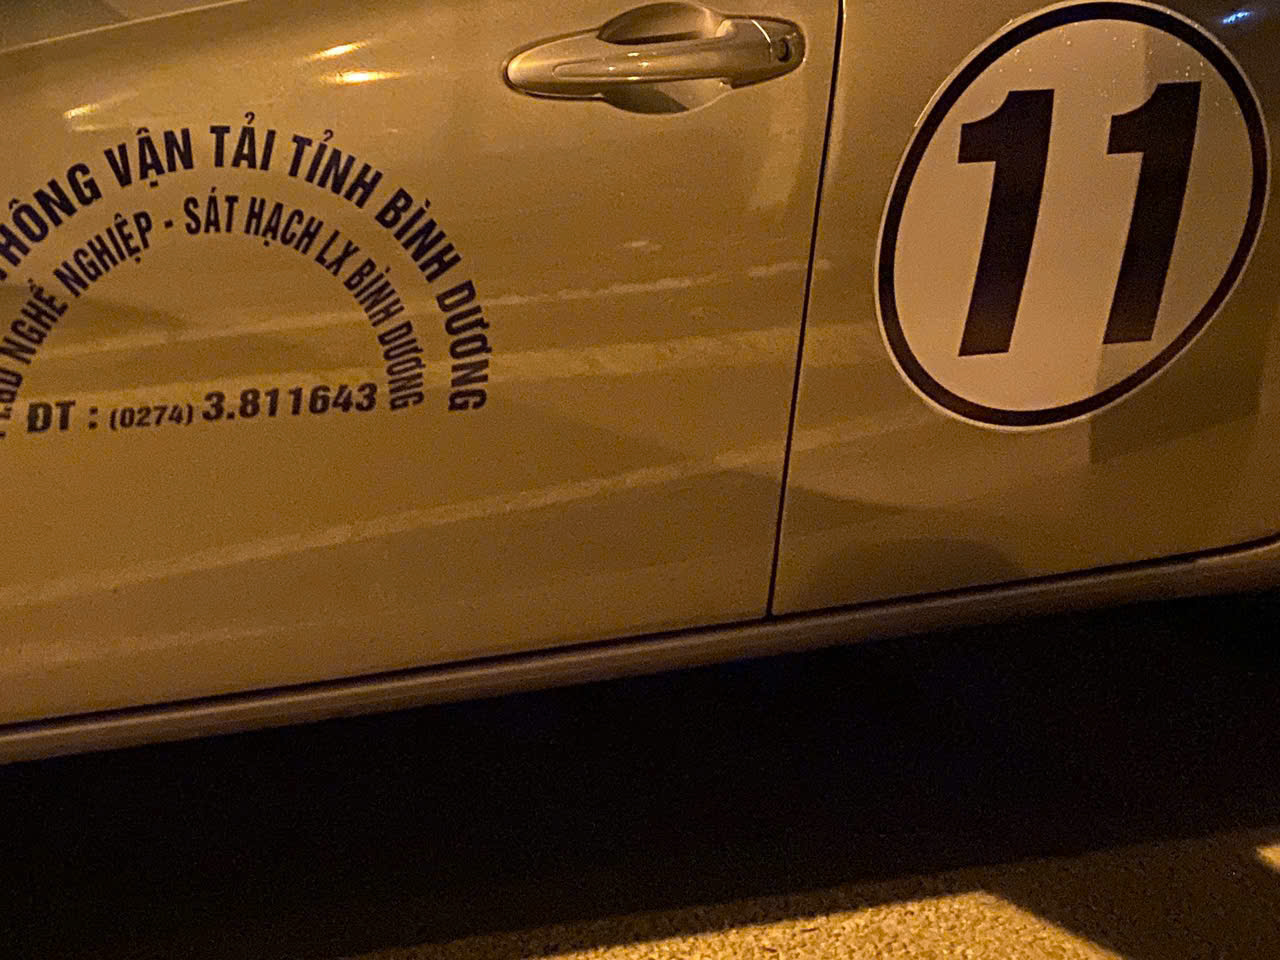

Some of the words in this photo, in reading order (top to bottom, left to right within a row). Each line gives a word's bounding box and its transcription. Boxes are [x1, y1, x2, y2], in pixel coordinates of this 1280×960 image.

[52, 212, 153, 298] NGHIỆP
[164, 219, 174, 229] -
[183, 186, 239, 235] SÁT
[244, 196, 324, 255] HẠCH
[314, 229, 360, 277] LX
[343, 256, 405, 328] BÌNH
[377, 320, 426, 411] DƯƠNG
[104, 127, 194, 188] VẬN
[209, 111, 277, 171] TẢI
[288, 129, 384, 209] TỈNH
[375, 187, 462, 283] BÌNH
[436, 279, 492, 412] DƯƠNG
[957, 80, 1202, 358] 11
[109, 403, 193, 431] (0274)
[202, 382, 378, 422] 3.811643
